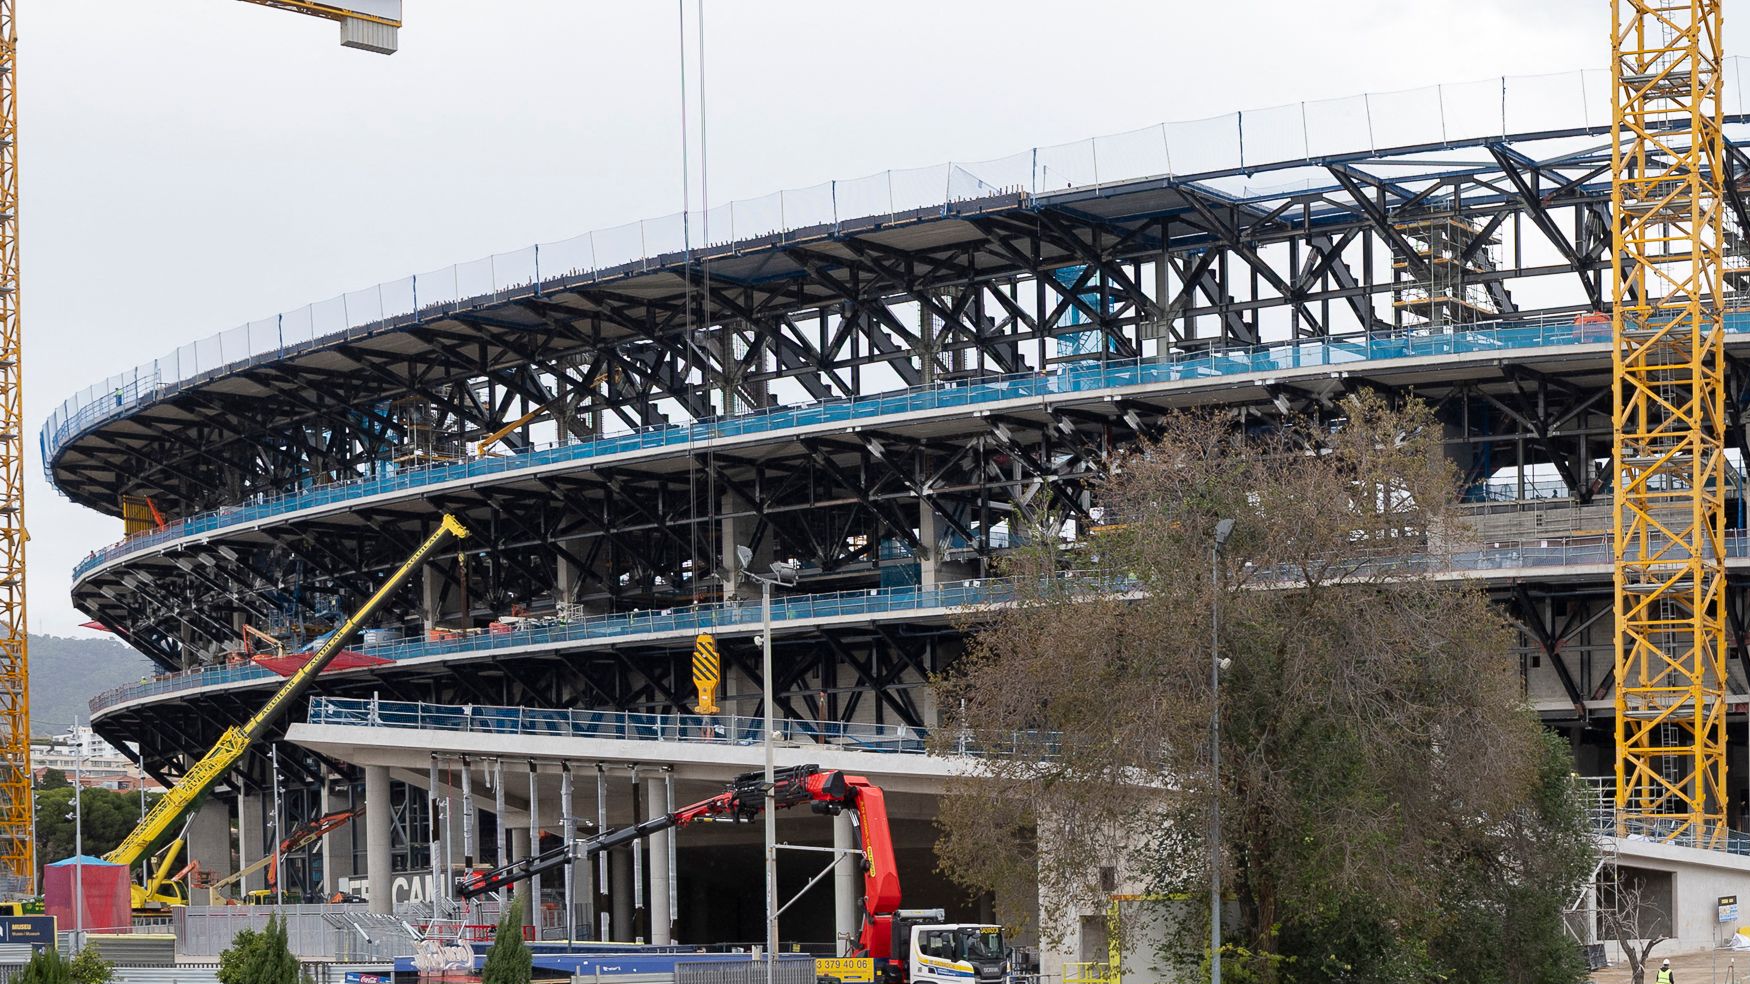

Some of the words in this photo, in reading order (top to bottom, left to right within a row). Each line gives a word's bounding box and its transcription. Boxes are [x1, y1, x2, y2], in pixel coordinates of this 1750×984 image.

[404, 531, 440, 569] AGUILAR
[309, 630, 345, 668] AGUILAR
[260, 680, 296, 717] AGUILAR
[825, 960, 840, 969] 379
[843, 960, 854, 969] 40
[856, 960, 867, 969] 06
